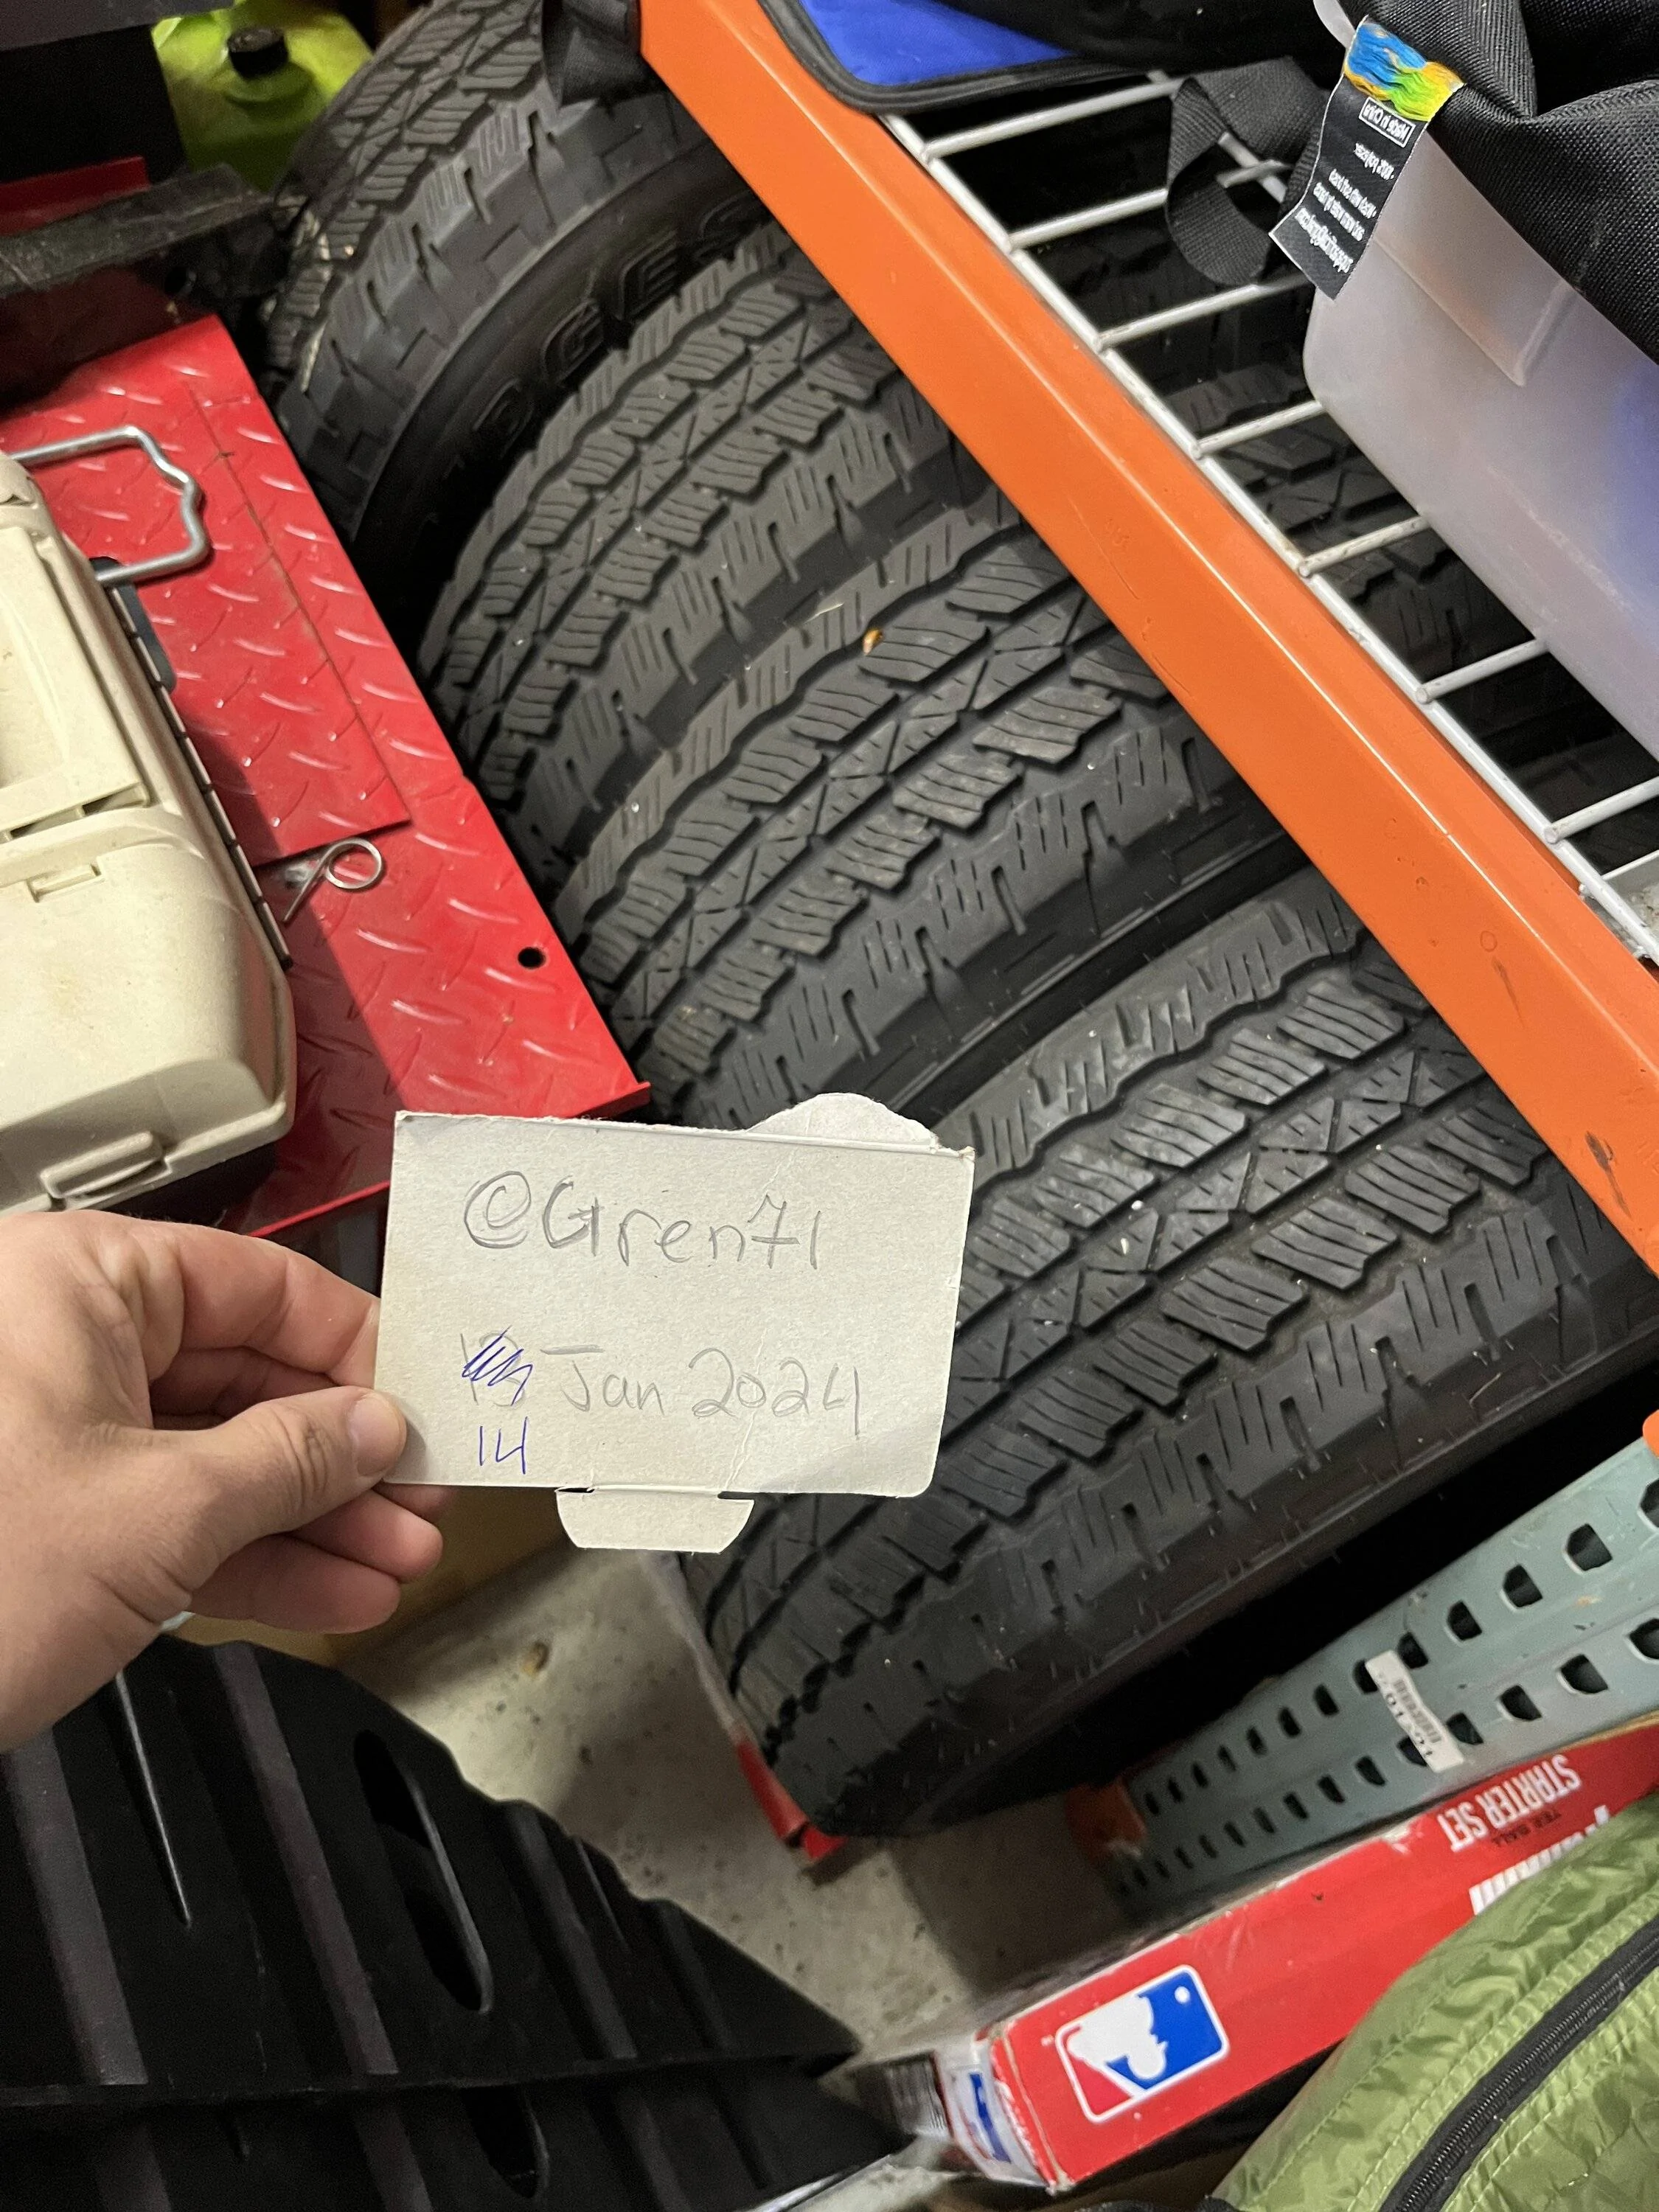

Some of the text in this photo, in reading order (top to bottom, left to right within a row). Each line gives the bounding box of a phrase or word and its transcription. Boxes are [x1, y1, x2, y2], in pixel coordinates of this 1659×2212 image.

[463, 1170, 824, 1270] @Gren71
[540, 1344, 666, 1415] Jan
[687, 1349, 861, 1440] 2024
[477, 1416, 529, 1475] 14
[1436, 1753, 1582, 1853] STARTER SET
